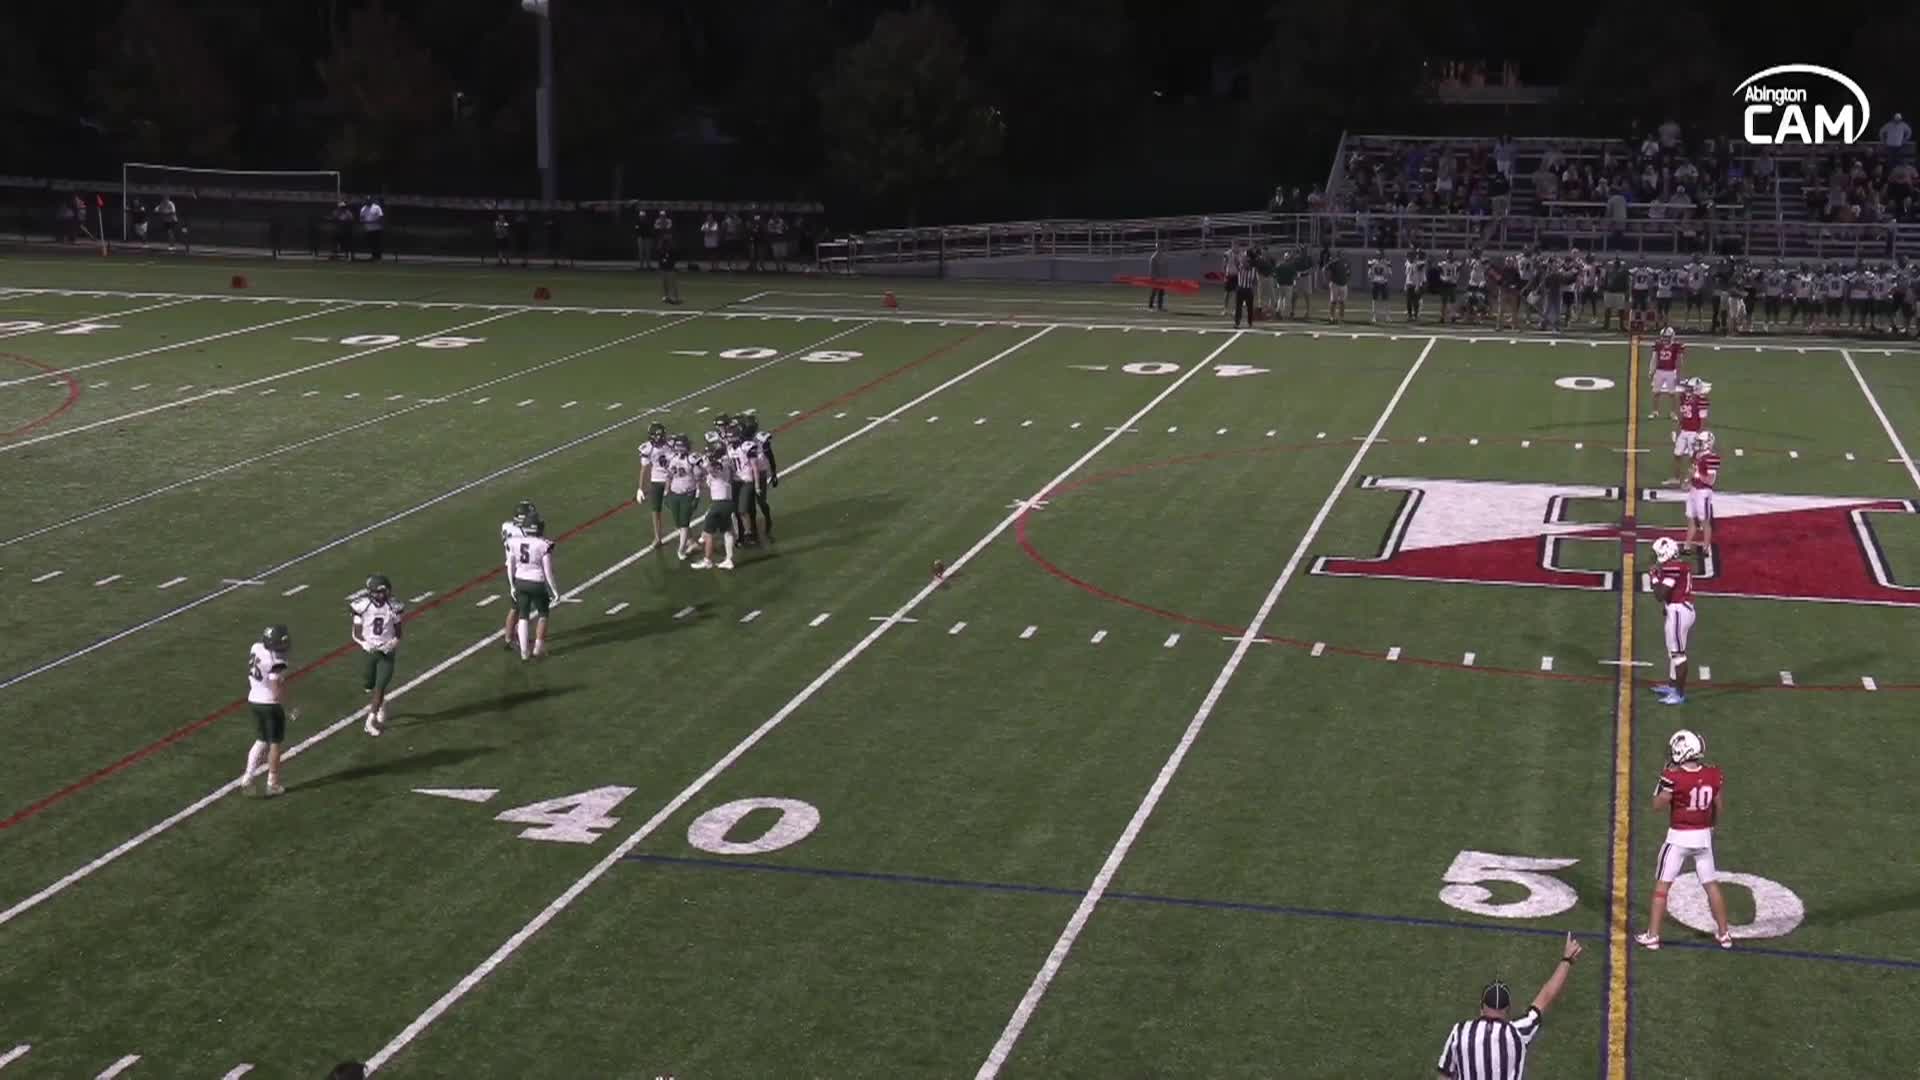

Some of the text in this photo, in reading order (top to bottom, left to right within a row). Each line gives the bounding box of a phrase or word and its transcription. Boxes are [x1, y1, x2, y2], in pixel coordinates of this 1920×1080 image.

[520, 543, 530, 564] 5
[373, 617, 384, 635] 8
[1686, 785, 1713, 811] 10
[494, 784, 821, 855] 40
